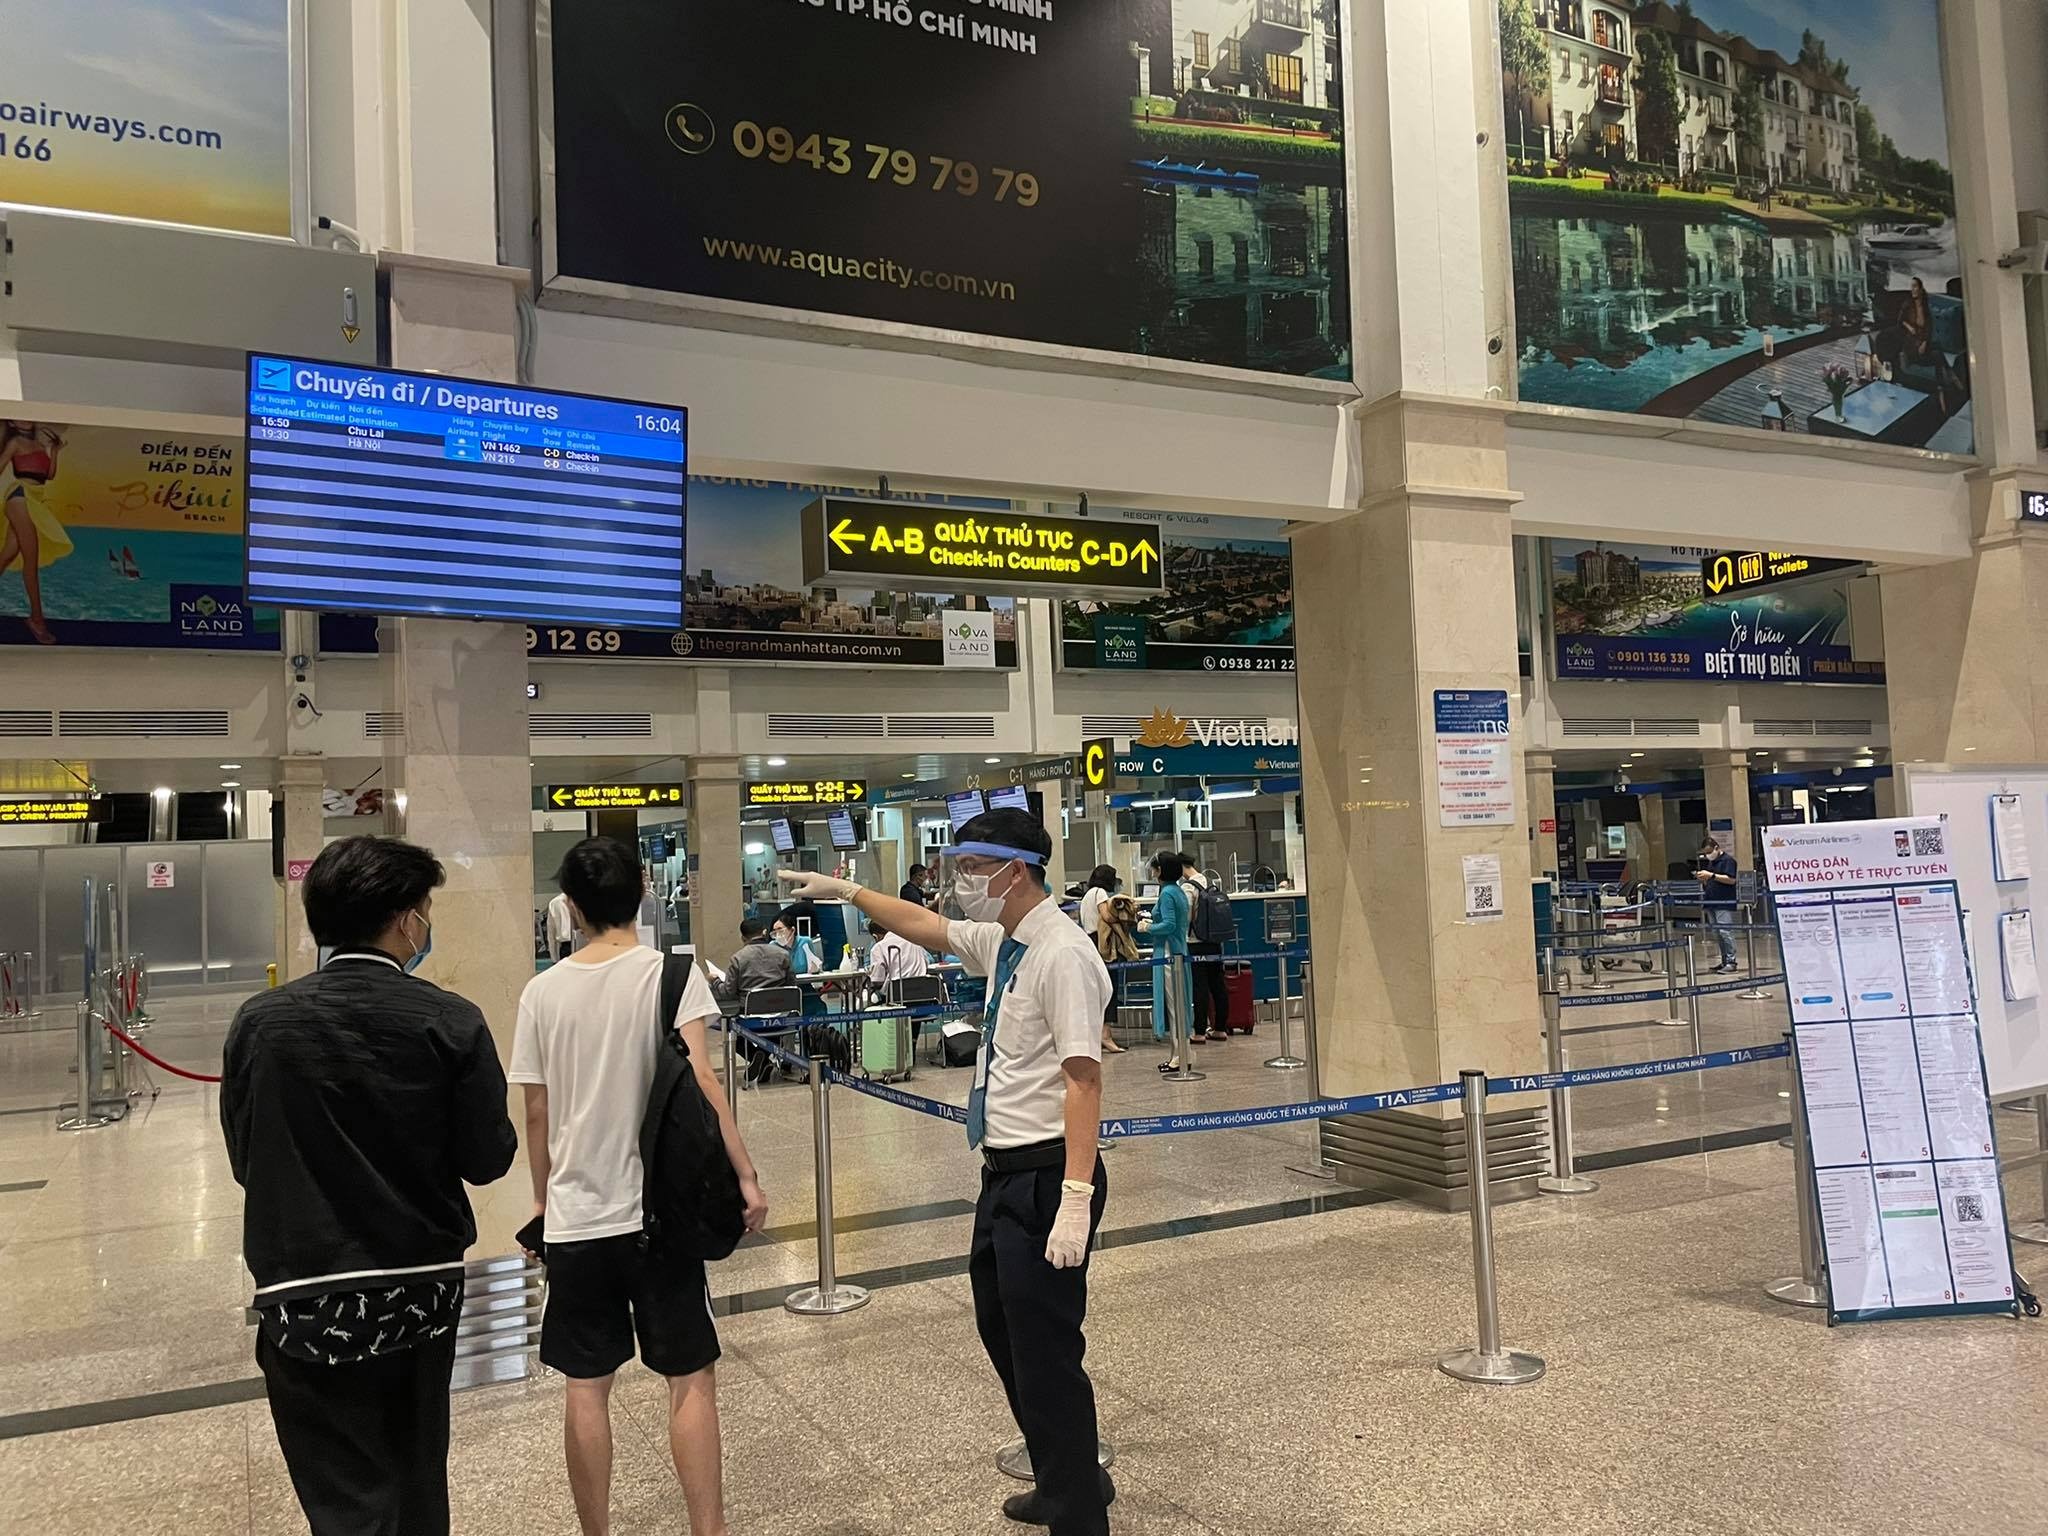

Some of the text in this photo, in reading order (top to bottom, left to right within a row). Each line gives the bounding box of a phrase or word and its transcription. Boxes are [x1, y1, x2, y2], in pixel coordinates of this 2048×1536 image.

[919, 11, 1036, 54] CHÍ MINH
[732, 120, 1039, 207] 0943 79 79 79
[703, 236, 1015, 300] www.aquacity.com.vn
[295, 370, 386, 400] Chuyến
[391, 382, 415, 403] đi
[437, 388, 559, 420] Departures
[252, 405, 398, 428] Scheduled Estimated Destination
[635, 414, 681, 434] 16:04
[261, 416, 600, 462] 16:50 Chu Lai VN 1462 C-D Check-in
[447, 427, 601, 451] Airlines Flight Row Remarks
[193, 444, 232, 460] ĐẾN
[261, 428, 600, 473] 19:30 Hà Nội VN 216 C-D Check-in
[109, 479, 232, 518] Bikini
[184, 513, 225, 523] BEACH
[1122, 510, 1162, 522] RESORT
[1176, 514, 1209, 525] VILLAS
[993, 522, 1033, 547] THỦ
[1036, 529, 1073, 552] TỤC
[870, 526, 1128, 567] A-B C-D
[929, 547, 1080, 573] Check-in Counters
[1768, 560, 1808, 577] Toilets
[181, 619, 243, 632] LAND
[547, 629, 576, 651] 12
[586, 630, 620, 652] 69
[699, 636, 901, 657] thegrandmanhattan.com.vn
[949, 642, 989, 652] LAND
[1105, 651, 1137, 659] LAND
[1567, 658, 1595, 668] LAND
[1616, 651, 1691, 665] 0901 136 339
[1219, 658, 1295, 670] 0938 221 22
[1704, 648, 1735, 678] BIỆT
[1738, 653, 1767, 680] THỰ
[1770, 647, 1801, 677] BIỂN
[1086, 745, 1104, 785] C
[1119, 758, 1164, 774] ROW C
[966, 774, 980, 789] C-2
[1009, 768, 1023, 783] C-1
[1064, 760, 1072, 775] C
[815, 781, 845, 792] C-D-E
[669, 789, 680, 801] B
[815, 792, 845, 803] F-G-H
[1786, 838, 1819, 846] Vietnam
[1773, 857, 1820, 871] HƯỚNG
[1775, 873, 1804, 884] KHAI
[1807, 869, 1834, 882] BÁO
[1837, 870, 1845, 880] Y
[1867, 866, 1903, 879] TRỰC
[1664, 989, 1681, 998] TIA
[1900, 1003, 1907, 1013] 2
[1962, 1000, 1970, 1010] 3
[760, 1019, 780, 1027] TIA
[1510, 1077, 1538, 1090] TIA
[1729, 1050, 1752, 1063] TIA
[831, 1071, 954, 1119] TIA TIA
[1099, 1121, 1126, 1135] IA
[1309, 1104, 1326, 1114] SƠN
[1374, 1093, 1407, 1108] TIA
[1446, 1087, 1461, 1095] TAN
[1860, 1150, 1868, 1160] 4
[1921, 1147, 1929, 1157] 5
[1983, 1143, 1991, 1154] 6
[1882, 1294, 1889, 1304] 7
[1944, 1290, 1951, 1300] 8
[2005, 1286, 2012, 1297] 9
